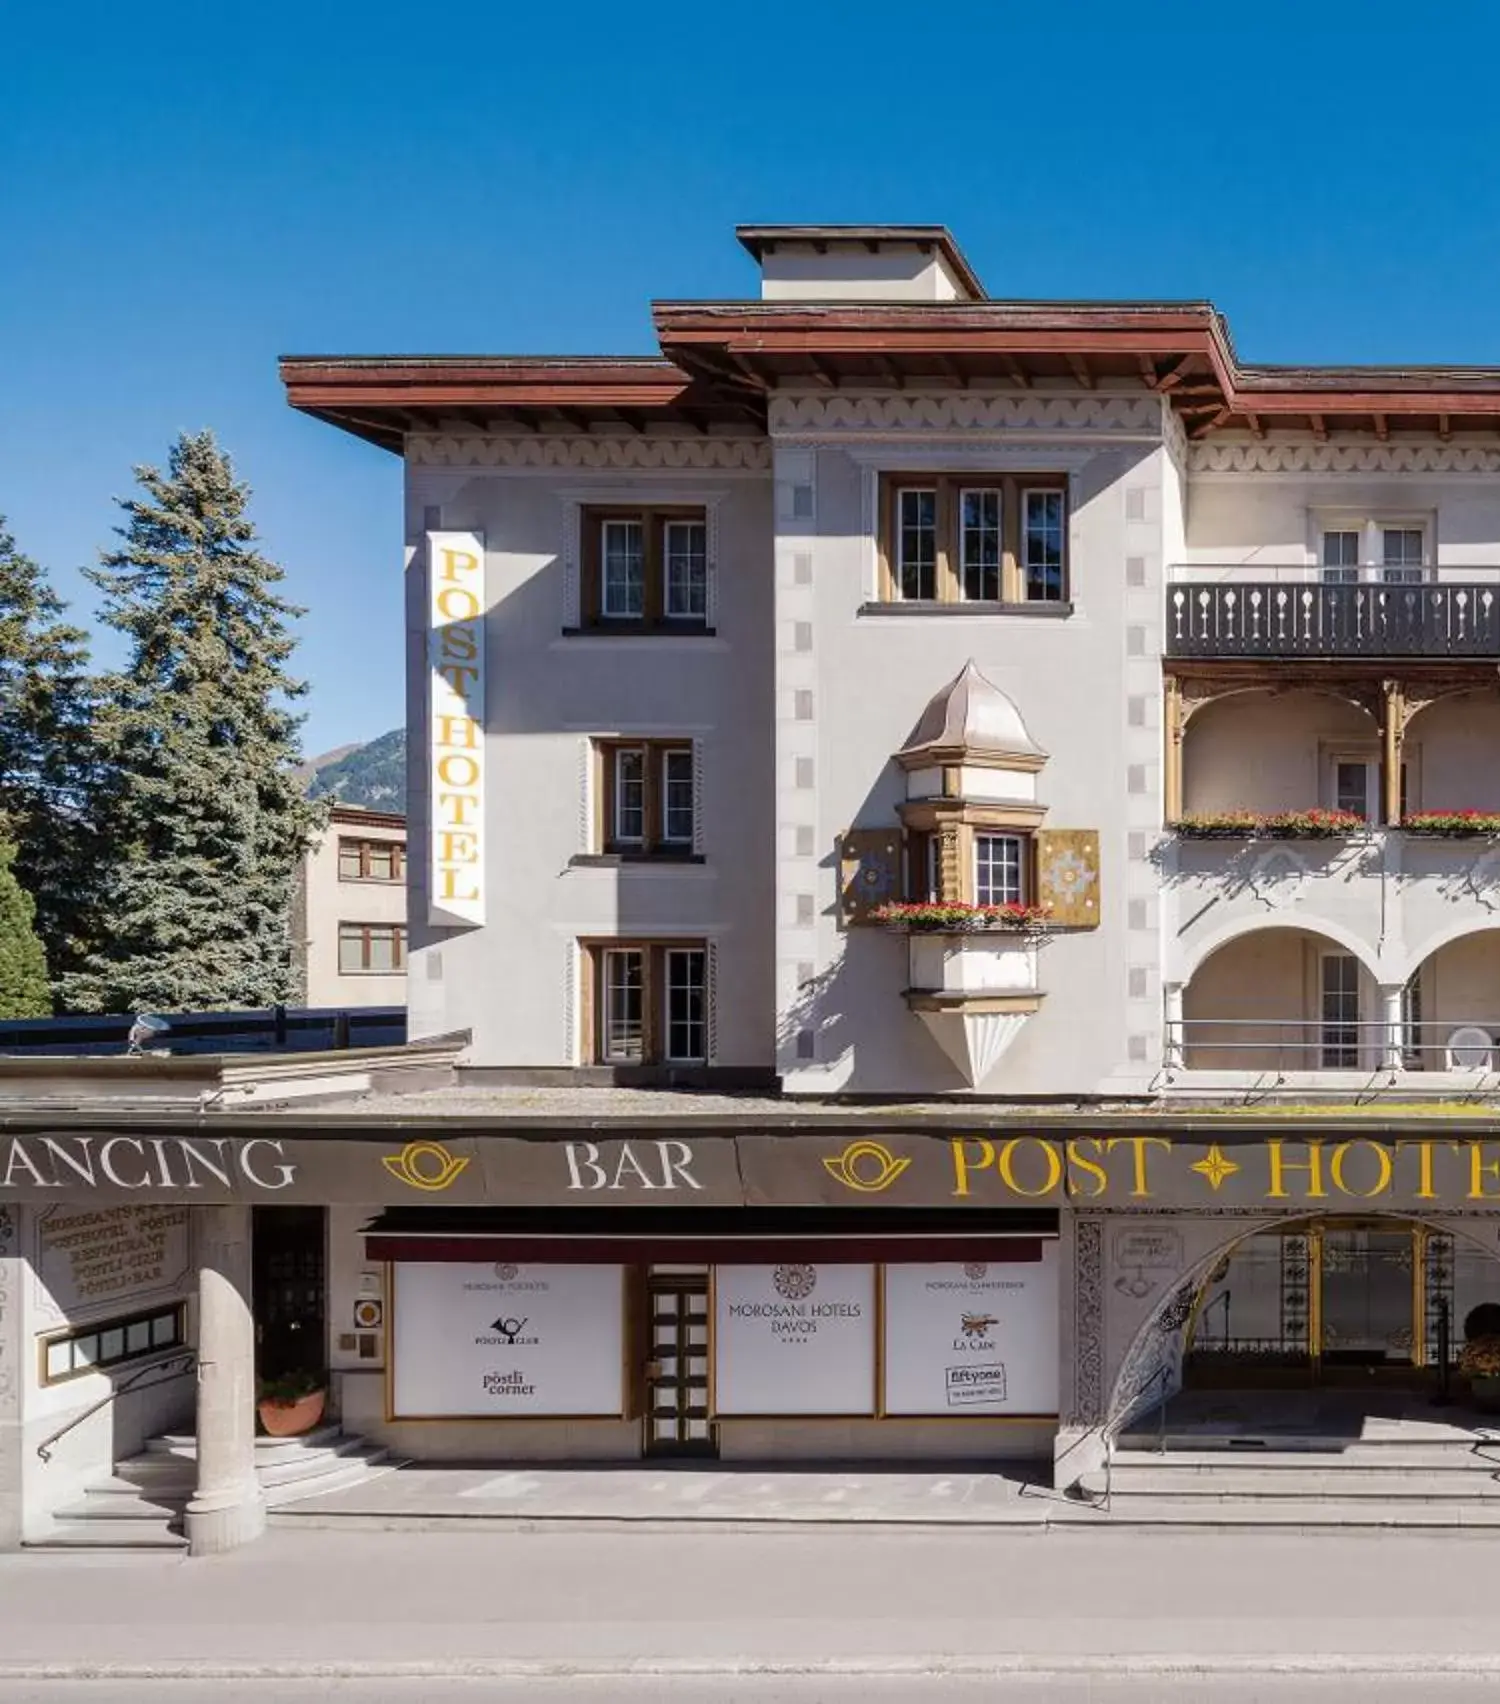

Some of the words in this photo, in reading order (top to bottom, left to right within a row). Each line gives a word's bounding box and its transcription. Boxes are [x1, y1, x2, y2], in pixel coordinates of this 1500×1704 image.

[436, 548, 480, 698] POST
[434, 714, 483, 900] HOTEL
[565, 1140, 705, 1189] BAR
[951, 1136, 1172, 1196] POST
[729, 1304, 805, 1317] MOROSANI
[811, 1304, 861, 1317] HOTELS
[771, 1320, 816, 1333] DAVOS
[483, 1370, 523, 1388] pöstli
[489, 1384, 535, 1395] corner
